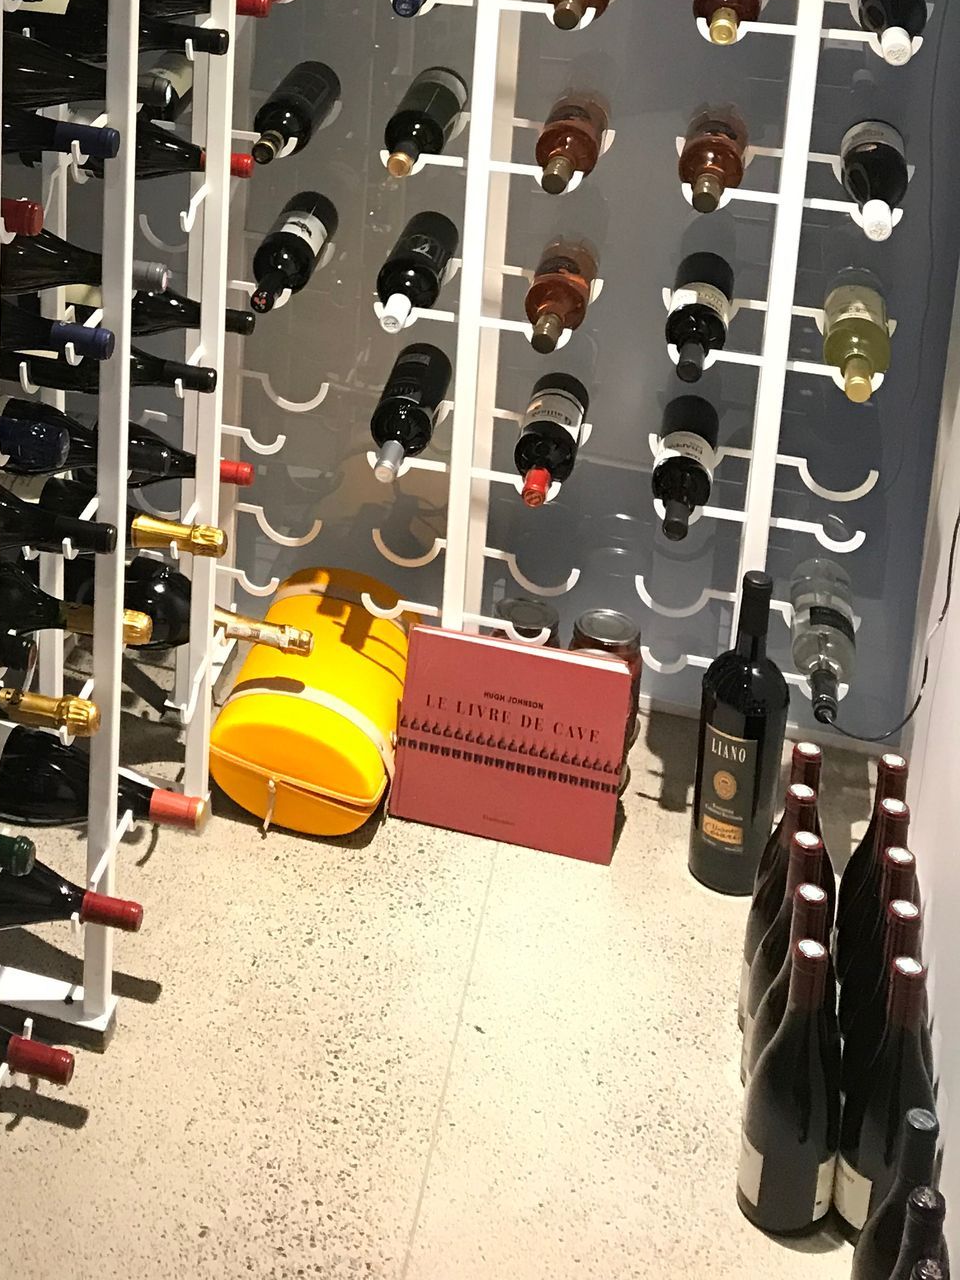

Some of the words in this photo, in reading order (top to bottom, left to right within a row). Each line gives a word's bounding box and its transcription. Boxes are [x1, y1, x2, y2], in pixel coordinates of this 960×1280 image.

[484, 691, 506, 701] HUGH
[508, 696, 545, 710] JOHNSON
[425, 694, 448, 710] LE
[456, 700, 512, 725] LIVRE
[520, 714, 545, 732] DE
[553, 720, 601, 745] CAVE
[711, 737, 747, 764] LIANO
